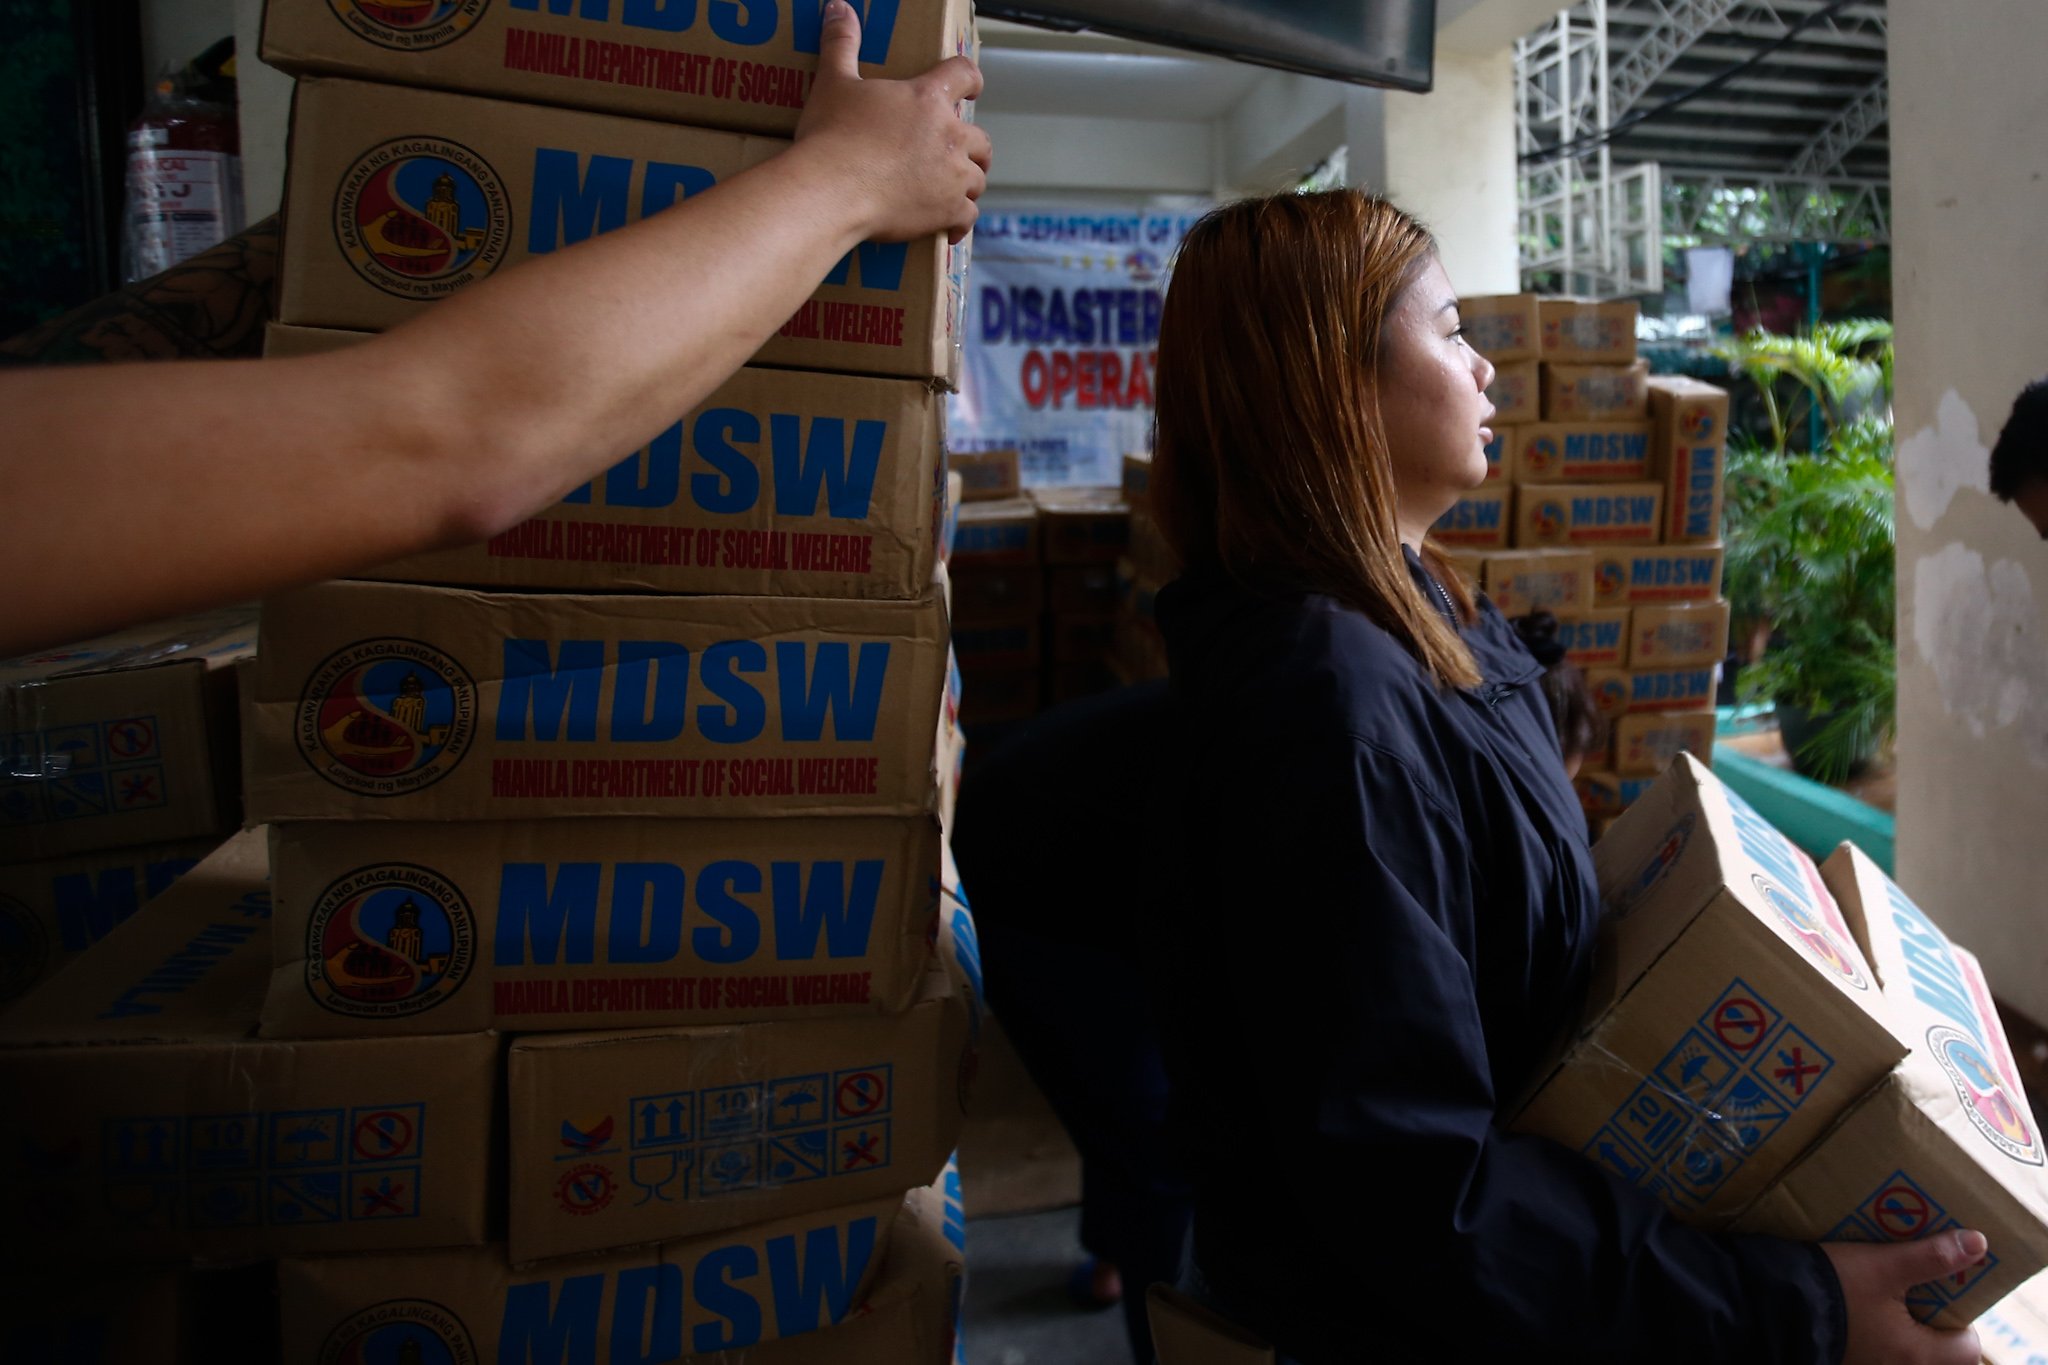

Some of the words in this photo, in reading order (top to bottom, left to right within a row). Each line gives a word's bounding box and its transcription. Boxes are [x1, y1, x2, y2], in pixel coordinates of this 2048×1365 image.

[504, 27, 580, 78] MANILA
[583, 39, 711, 96] DEPARTMENT
[712, 57, 738, 100] OF
[738, 62, 804, 109] SOCIAL
[369, 151, 389, 166] NG
[391, 142, 489, 181] KAGALINGANG
[482, 182, 506, 264] PANLIPUNAN
[823, 301, 904, 346] WELFARE
[981, 286, 1163, 344] DISASTER
[1021, 350, 1157, 409] OPERA
[562, 408, 886, 520] DSW
[1564, 433, 1648, 461] MDSW
[1571, 496, 1656, 525] MDSW
[488, 519, 563, 560] MANILA
[567, 521, 694, 567] DEPARTMENT
[697, 528, 720, 568] OF
[722, 529, 788, 570] SOCIAL
[792, 533, 873, 573] WELFARE
[1630, 558, 1715, 585] MDSW
[331, 656, 351, 670] NG
[353, 645, 456, 677] KAGALINGANG
[447, 677, 471, 754] PANLIPUNAN
[495, 638, 890, 745] MDSW
[1632, 671, 1710, 699] MDSW
[492, 760, 568, 798] MANILA
[572, 760, 700, 797] DEPARTMENT
[702, 759, 726, 796] OF
[729, 758, 794, 796] SOCIAL
[798, 758, 878, 795] WELFARE
[332, 883, 353, 901] NG
[355, 870, 451, 904] KAGALINGANG
[448, 902, 469, 980] PANLIPUNAN
[494, 860, 885, 966] MDSW
[493, 980, 569, 1016] MANILA
[572, 977, 697, 1014] DEPARTMENT
[699, 976, 723, 1010] OF
[725, 975, 789, 1008] SOCIAL
[792, 972, 873, 1005] WELFARE
[716, 1091, 748, 1113] 10
[1629, 1095, 1661, 1127] 10
[208, 1120, 244, 1148] 10
[497, 1216, 876, 1365] MDSW
